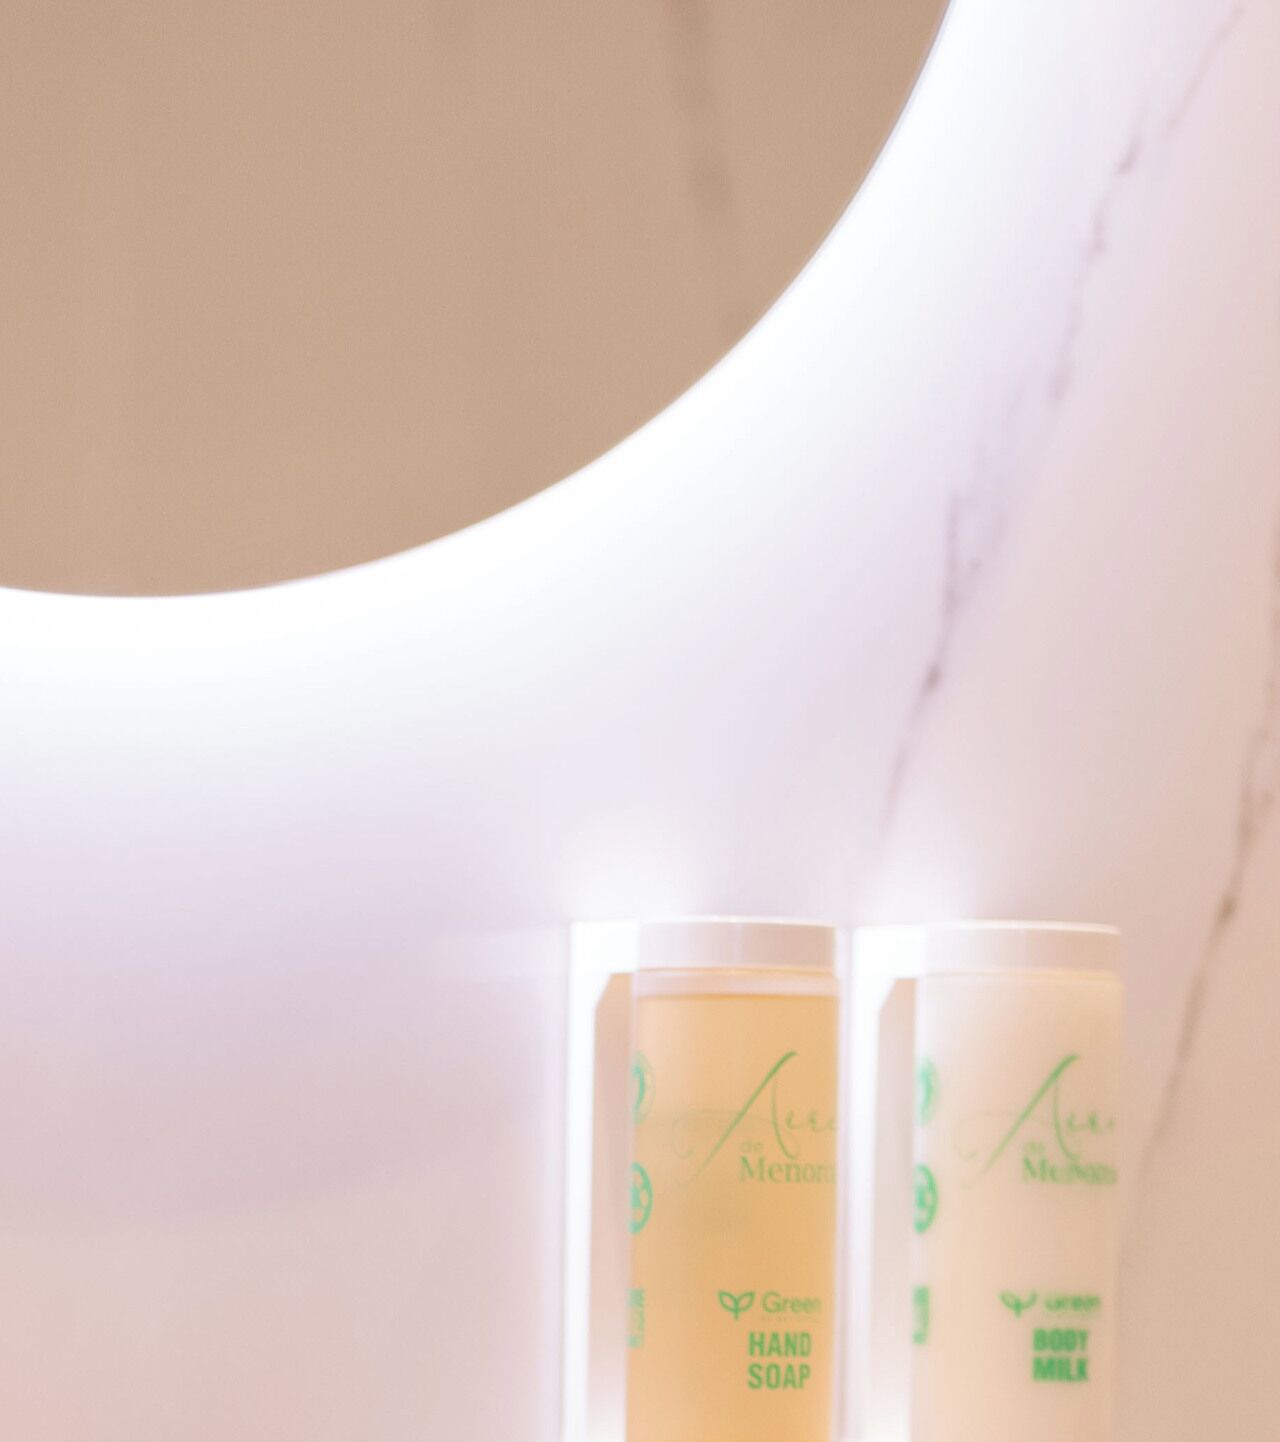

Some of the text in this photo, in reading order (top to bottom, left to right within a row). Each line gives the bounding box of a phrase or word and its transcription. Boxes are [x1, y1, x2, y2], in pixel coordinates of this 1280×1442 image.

[761, 1290, 823, 1313] Green
[748, 1331, 812, 1357] HAND
[1032, 1327, 1088, 1353] BODY
[748, 1362, 812, 1390] SOAP
[1032, 1357, 1089, 1383] MILK
